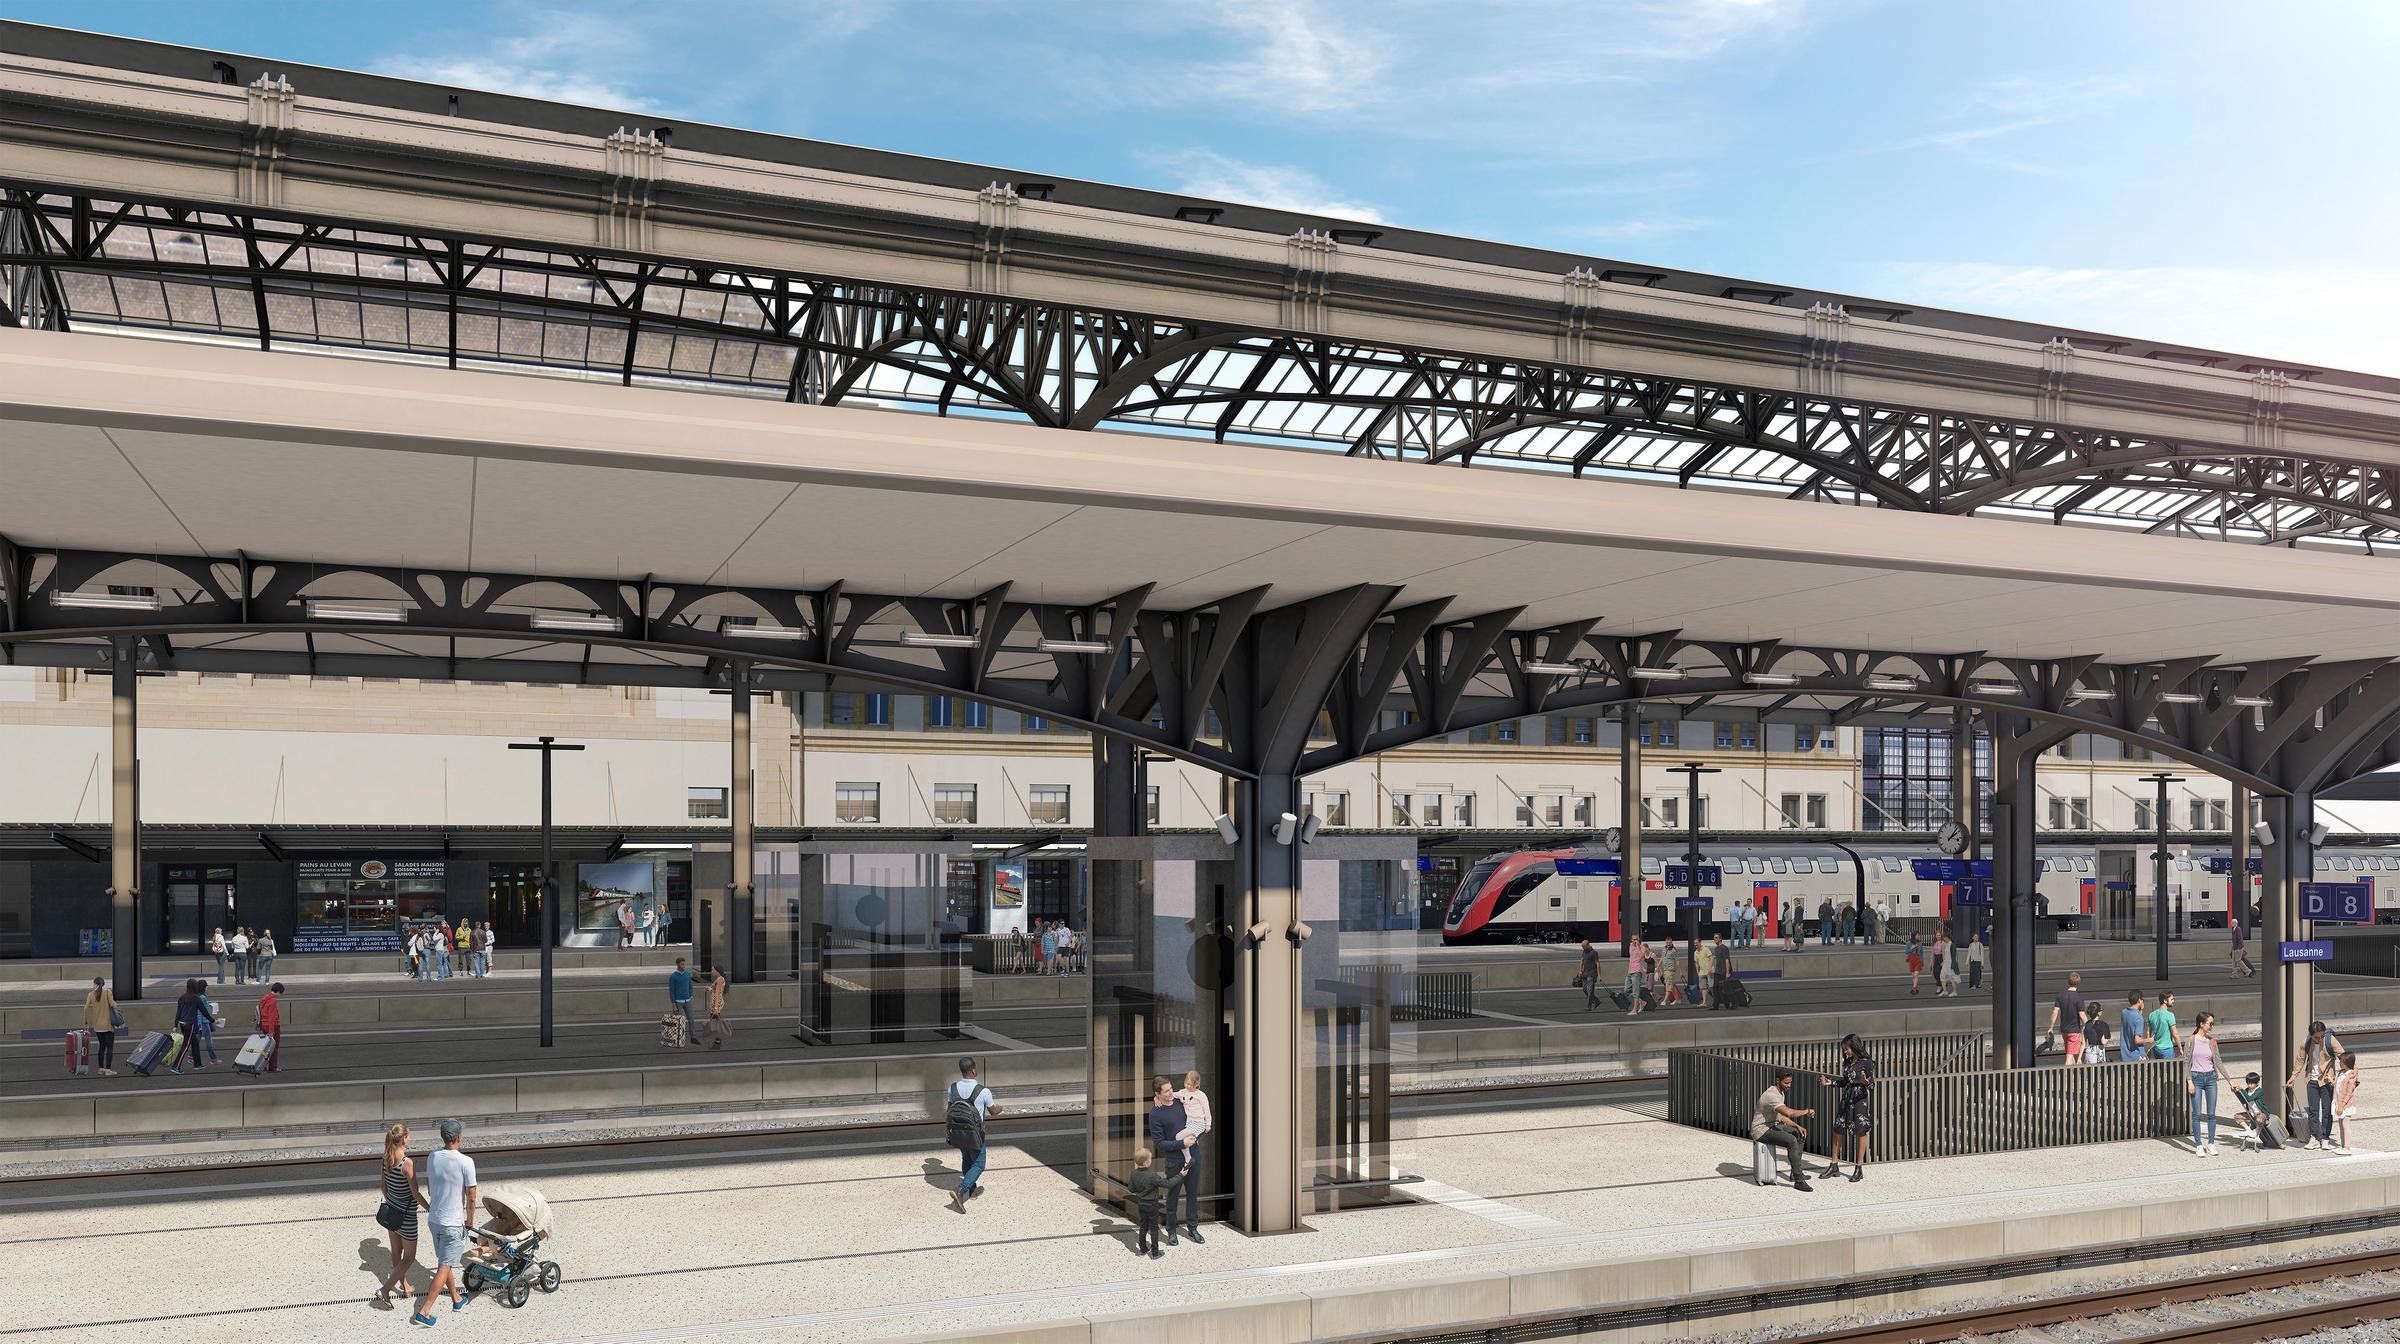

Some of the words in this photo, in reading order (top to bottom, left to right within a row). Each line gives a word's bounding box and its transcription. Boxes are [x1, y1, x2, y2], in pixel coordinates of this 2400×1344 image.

[1669, 872, 1674, 881] 5
[1681, 872, 1687, 881] D
[1698, 873, 1703, 882] D
[1711, 873, 1716, 882] 6
[1964, 886, 1972, 900] 7
[2309, 895, 2323, 913] D
[2345, 896, 2357, 914] 8
[2283, 947, 2324, 957] Lausanne
